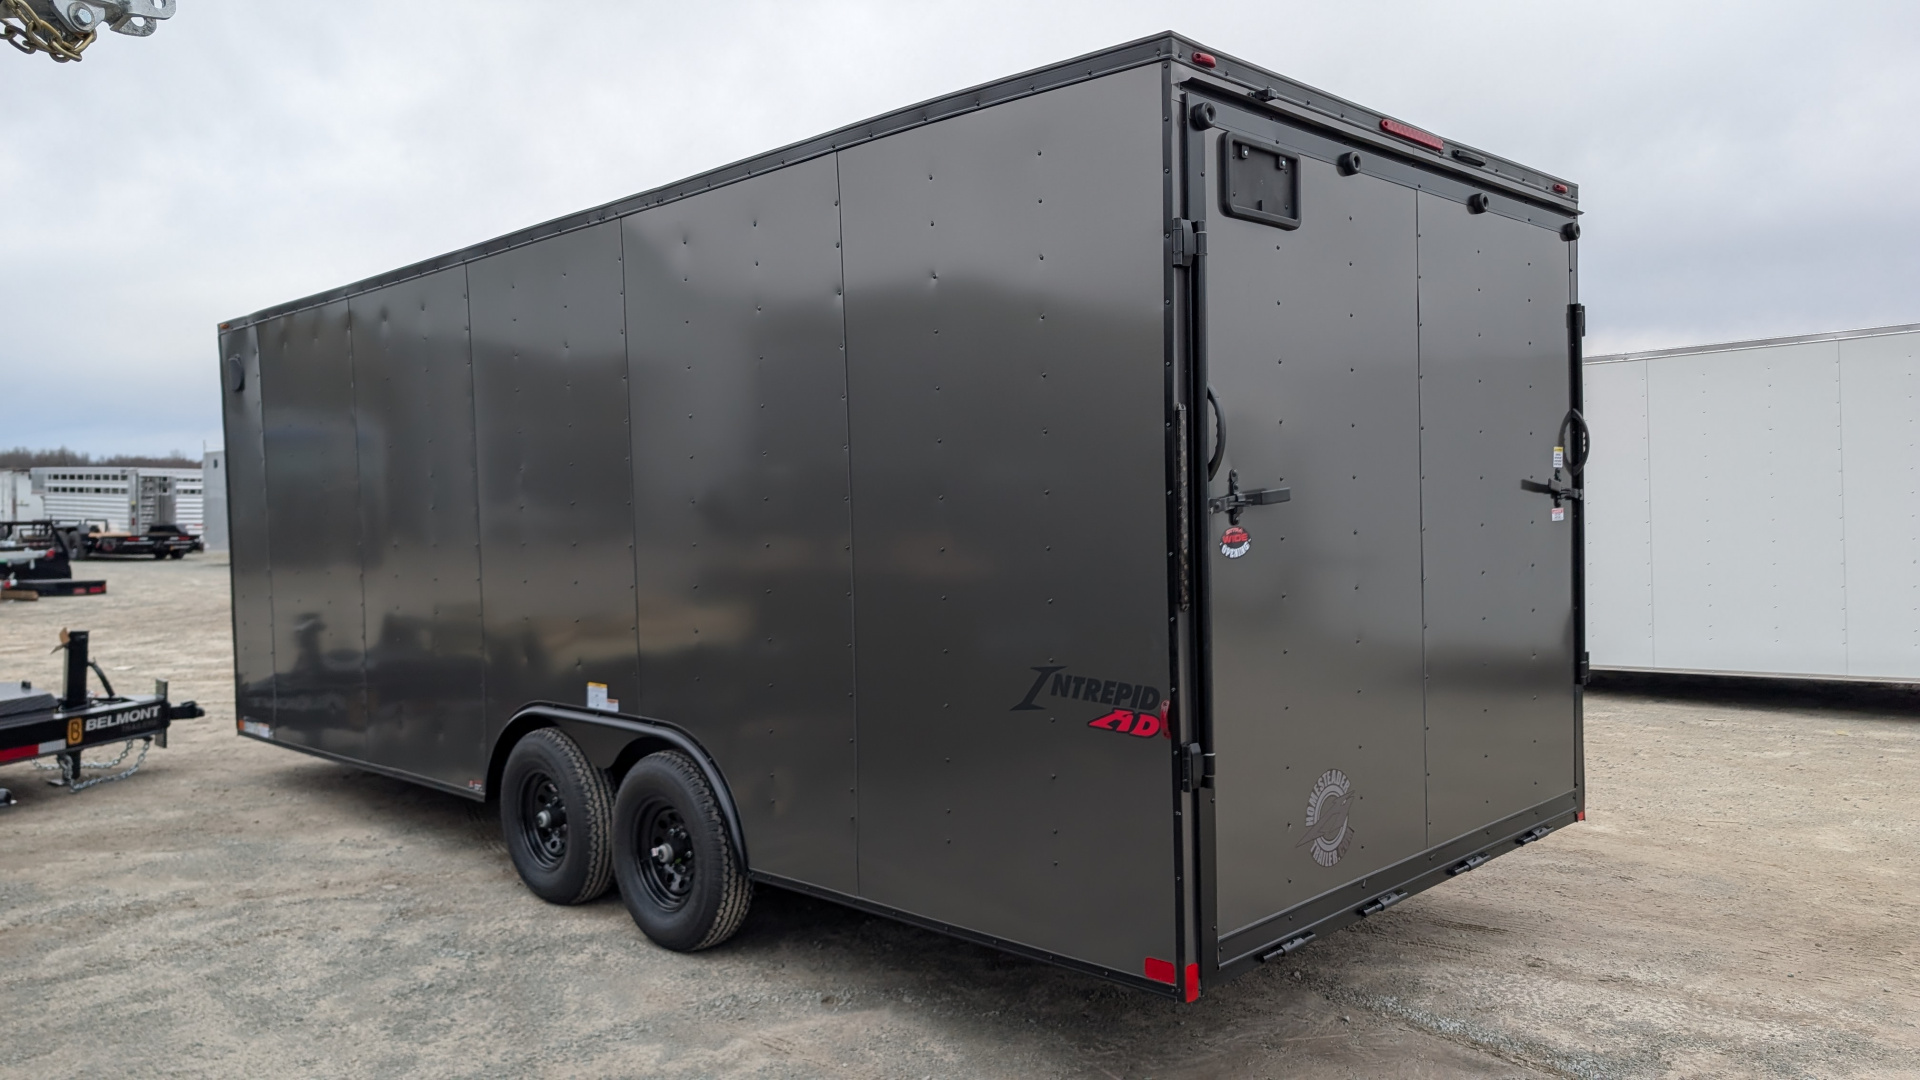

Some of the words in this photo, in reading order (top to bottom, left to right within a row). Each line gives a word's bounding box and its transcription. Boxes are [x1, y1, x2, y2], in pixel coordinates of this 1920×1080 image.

[1221, 541, 1250, 558] OPENING
[1222, 533, 1248, 543] WIDE
[1010, 666, 1161, 711] INTREPID
[85, 705, 161, 731] BELMONT
[1305, 769, 1350, 826] HOMESTEADER
